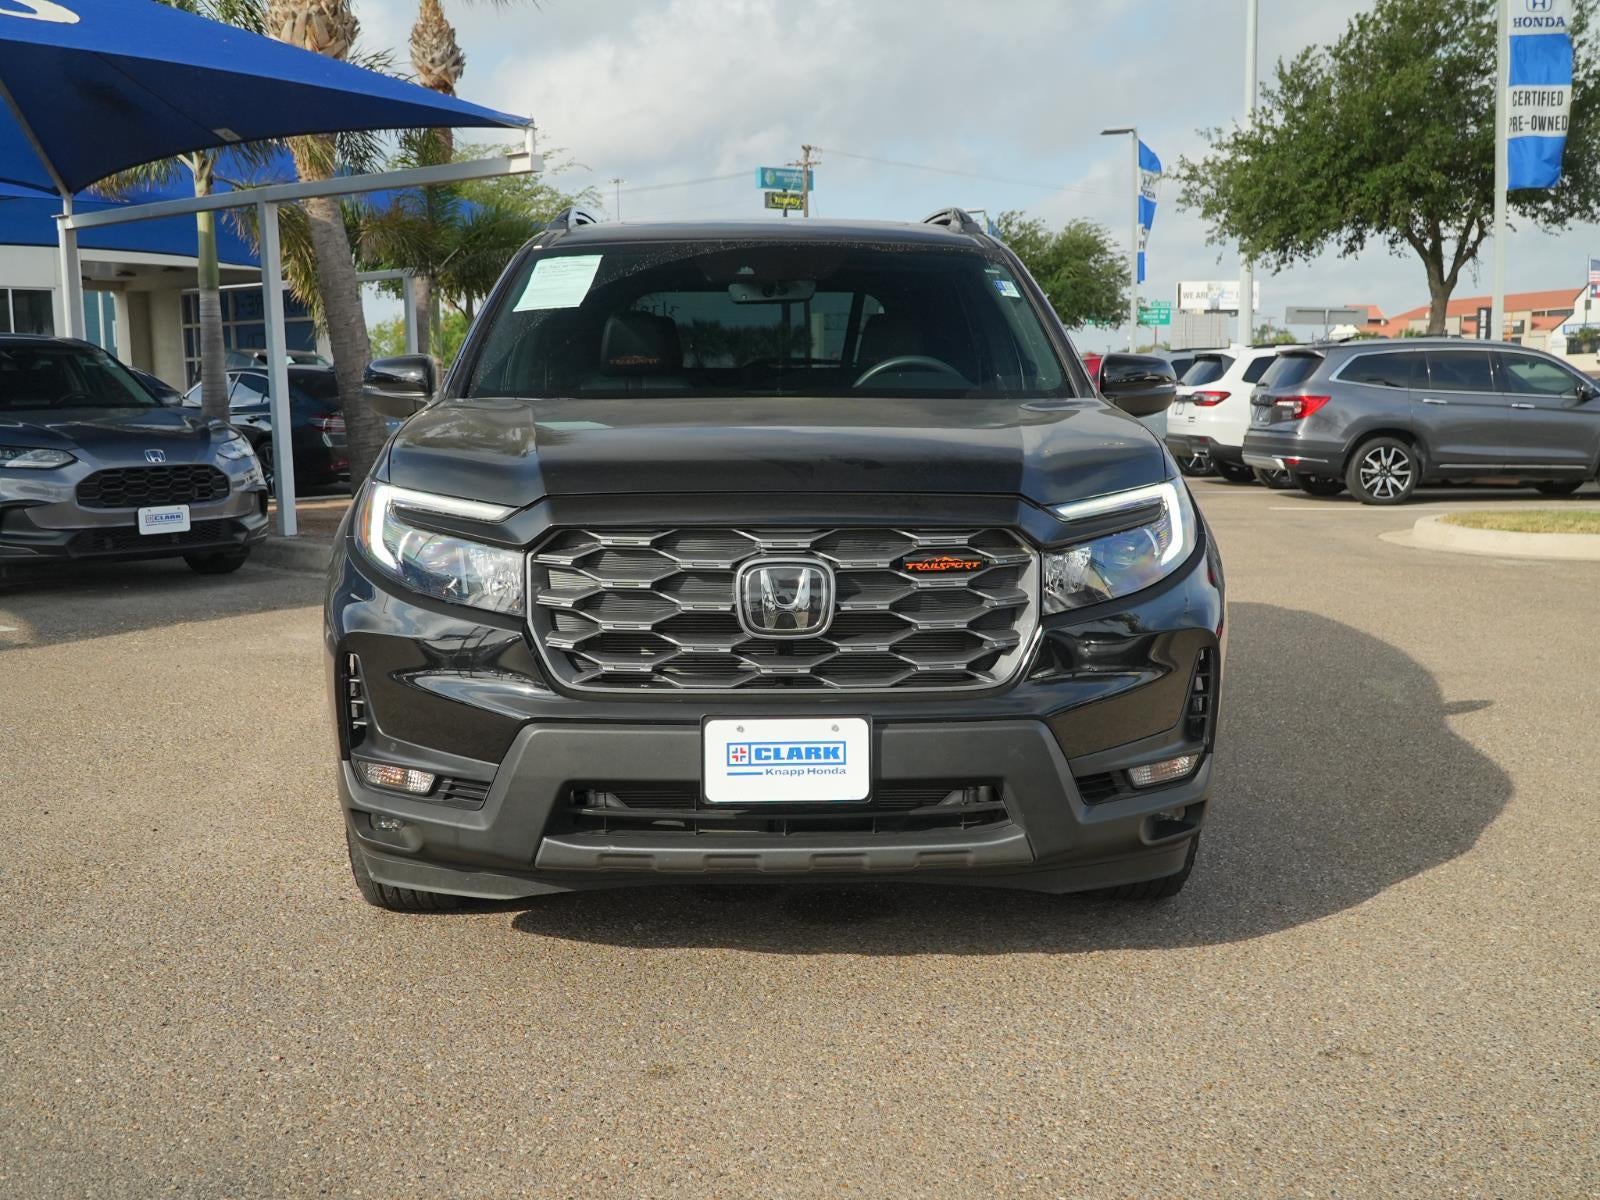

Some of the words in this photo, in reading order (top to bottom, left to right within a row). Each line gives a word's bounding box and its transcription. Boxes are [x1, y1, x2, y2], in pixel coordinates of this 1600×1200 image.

[1513, 16, 1566, 28] HONDA
[1512, 90, 1564, 107] CERTIFIED
[1183, 291, 1194, 299] WE
[905, 560, 981, 571] TRAILSPORT
[754, 746, 841, 760] CLARK
[765, 768, 805, 777] Knapp
[807, 767, 846, 775] Honda
